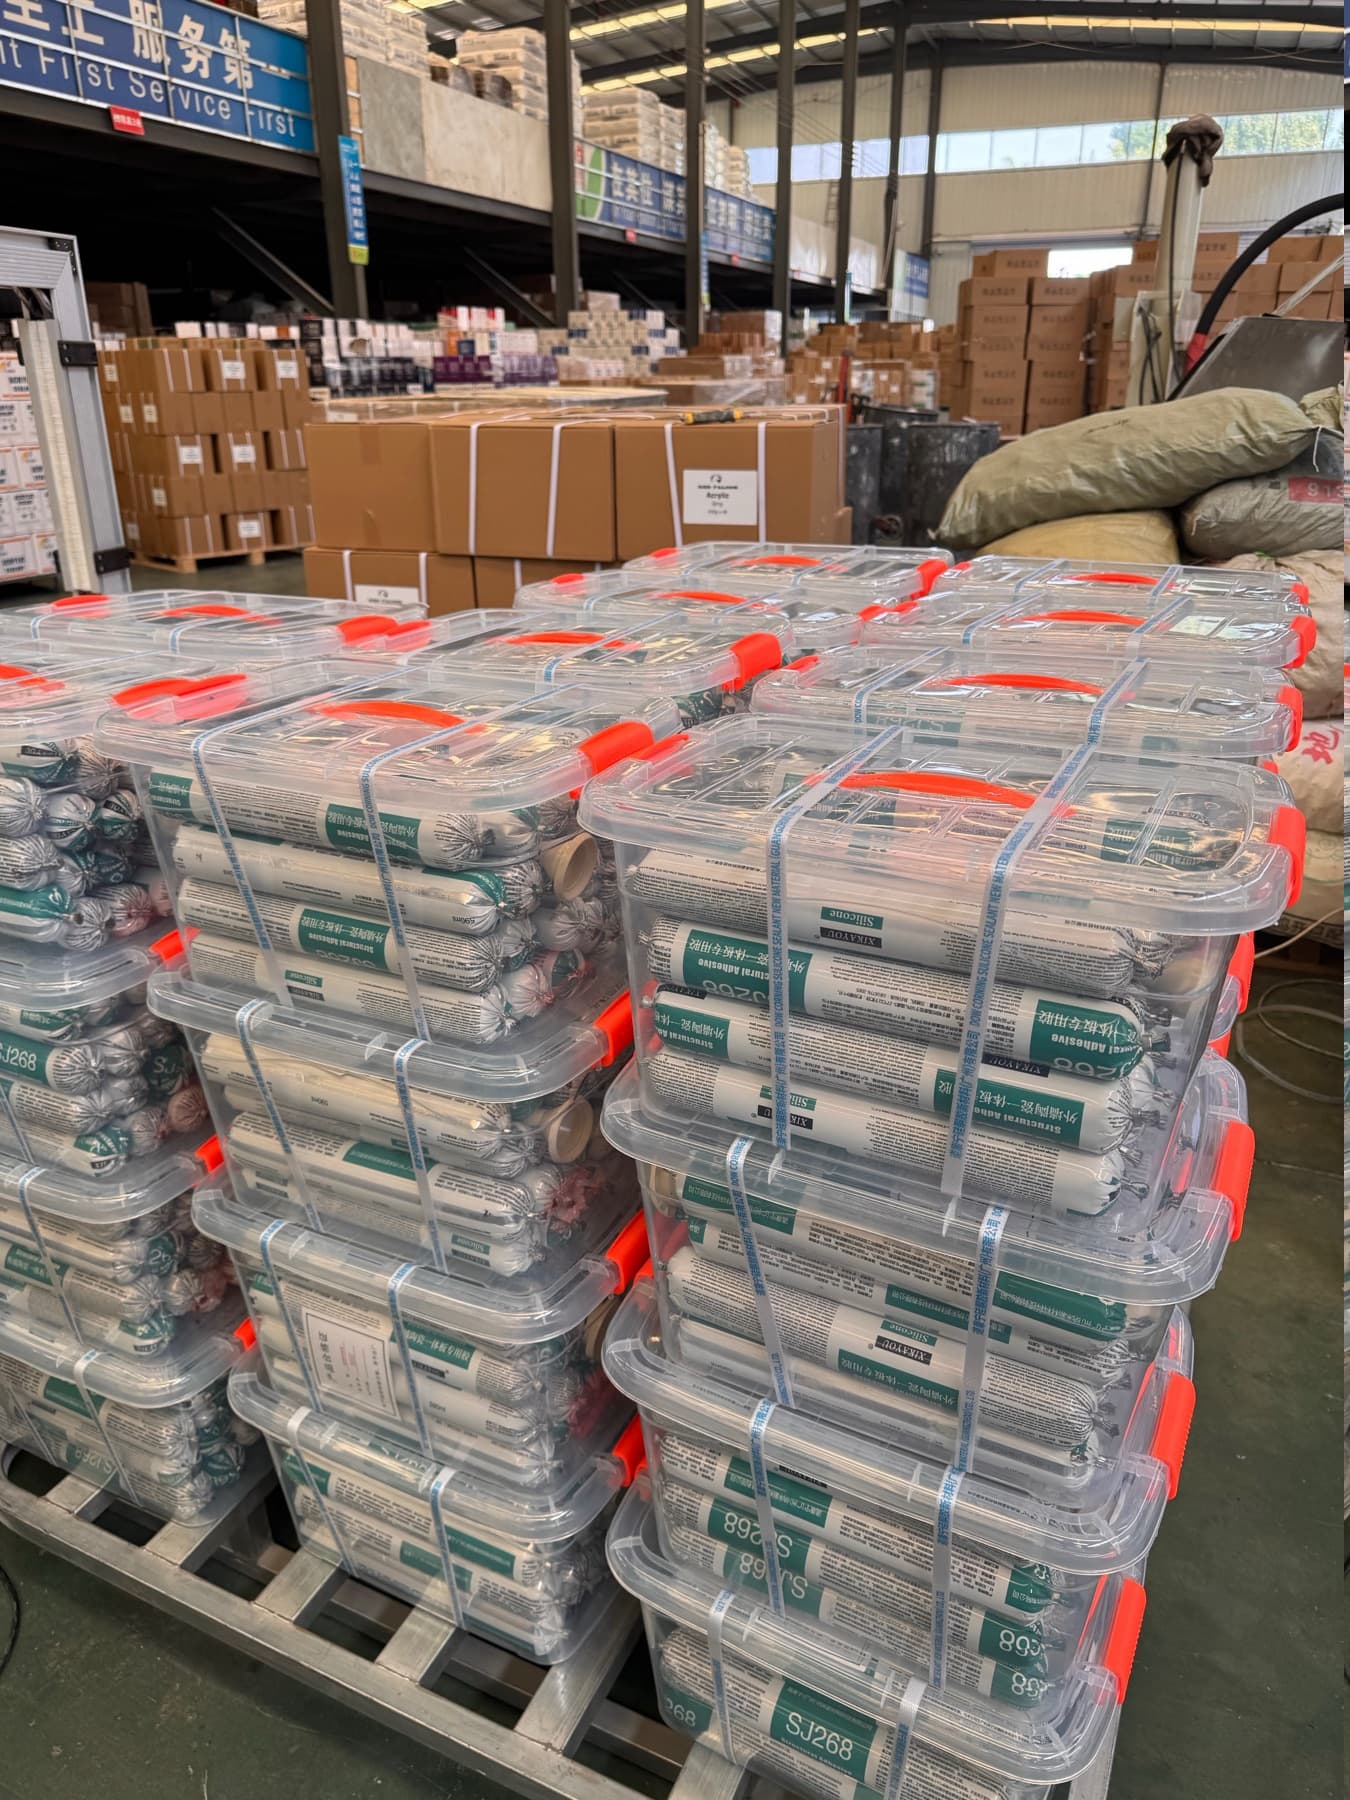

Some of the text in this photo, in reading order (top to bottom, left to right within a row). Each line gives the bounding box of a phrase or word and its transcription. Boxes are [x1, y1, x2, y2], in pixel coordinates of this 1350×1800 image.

[39, 46, 115, 91] First
[129, 71, 231, 121] Service
[771, 861, 782, 896] MATERIAL
[988, 884, 1003, 903] NEW
[772, 915, 783, 945] SEALANT
[829, 909, 874, 928] Silicone
[983, 904, 999, 938] SEALANT
[688, 937, 807, 974] 外瓷一体板专用胶
[697, 959, 740, 977] Adhesive
[973, 977, 988, 1009] CORNING
[971, 1010, 983, 1027] DOW
[675, 1032, 714, 1050] Structural
[1051, 1033, 1107, 1053] Adhesive
[938, 1079, 1079, 1125] 外墙陶瓷一体板胶
[1011, 1113, 1062, 1134] Structural
[889, 1323, 929, 1343] Silicone
[880, 1339, 927, 1361] XIKAYOU
[723, 1511, 793, 1558] S268
[785, 1711, 854, 1762] SJ268
